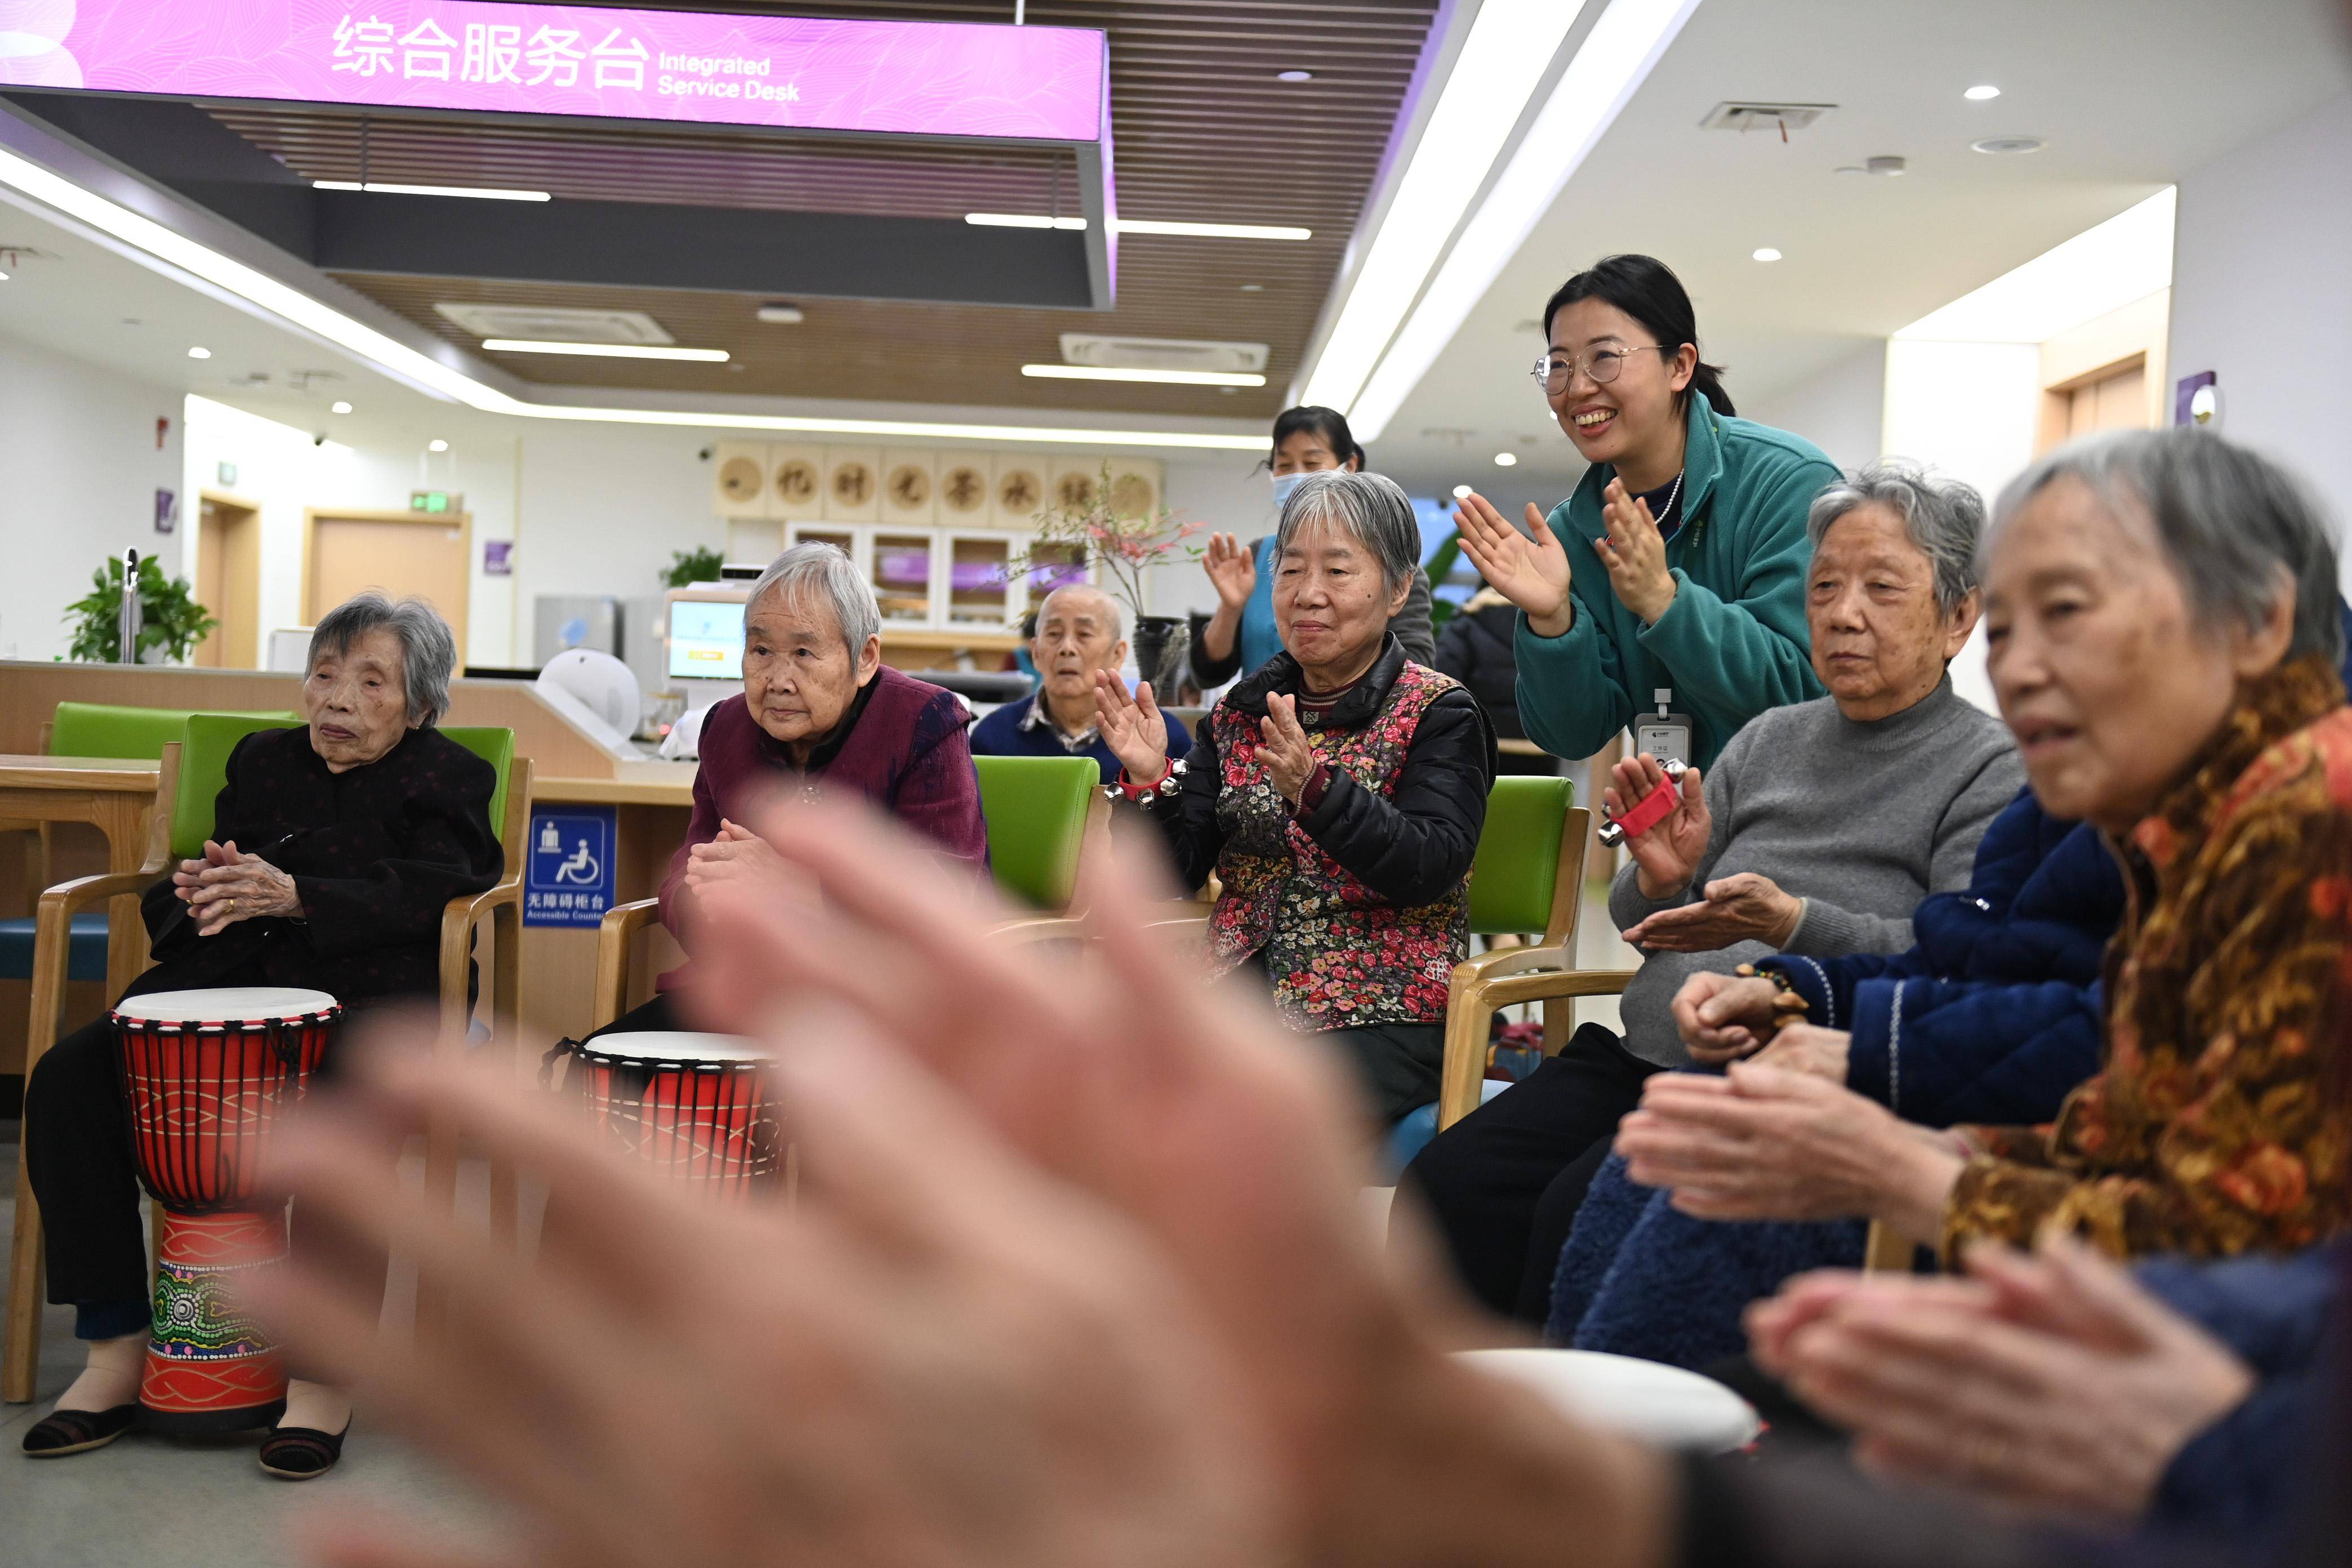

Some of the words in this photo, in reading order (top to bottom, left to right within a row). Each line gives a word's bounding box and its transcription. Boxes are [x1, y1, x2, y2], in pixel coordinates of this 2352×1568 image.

[332, 15, 649, 91] 综合服务台
[658, 51, 770, 77] Integrated
[657, 75, 740, 99] Service
[745, 80, 800, 101] Desk
[527, 910, 569, 919] Accessible
